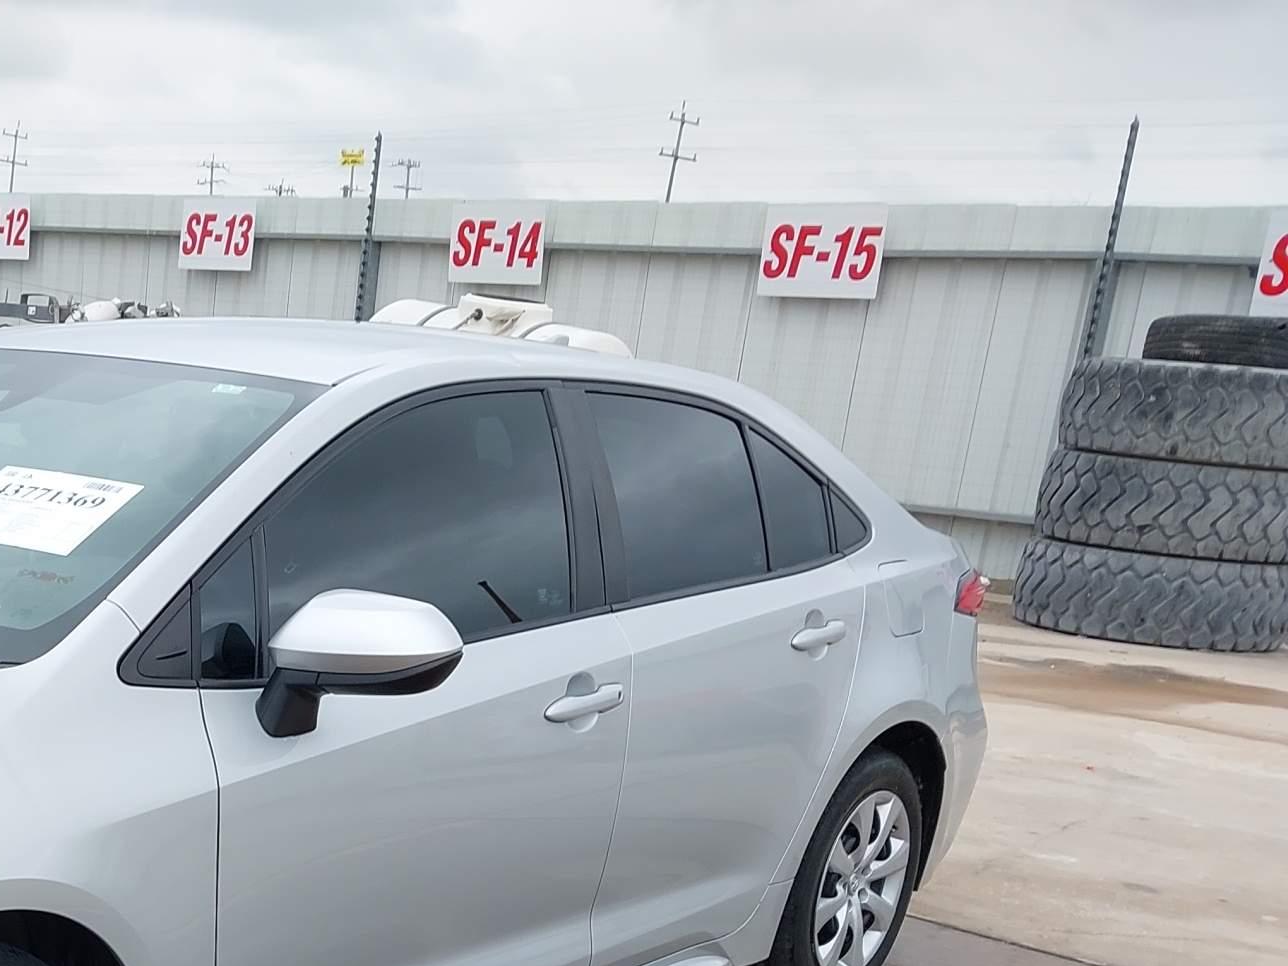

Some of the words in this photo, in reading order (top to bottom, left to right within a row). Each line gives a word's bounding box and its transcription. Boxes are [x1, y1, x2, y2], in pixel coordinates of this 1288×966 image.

[182, 213, 253, 257] SF-13
[453, 219, 542, 268] SF-14
[763, 224, 883, 281] SF-15
